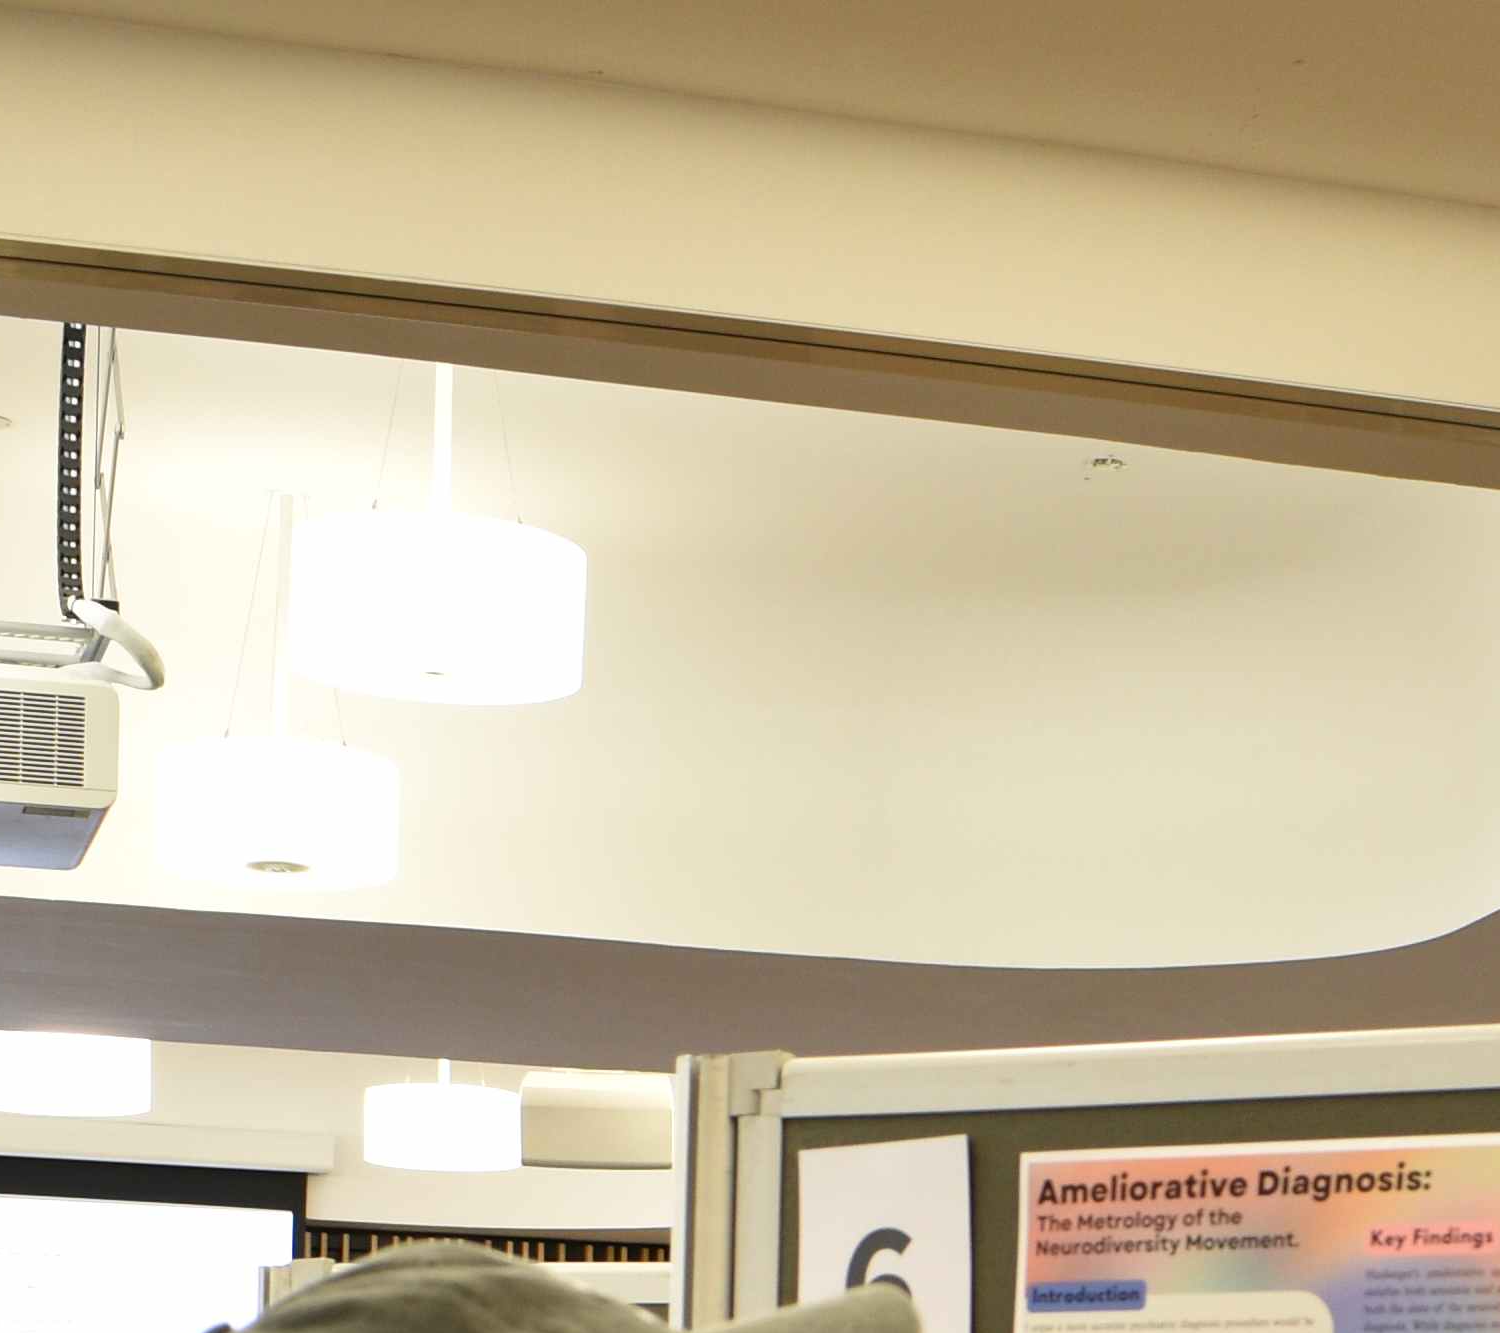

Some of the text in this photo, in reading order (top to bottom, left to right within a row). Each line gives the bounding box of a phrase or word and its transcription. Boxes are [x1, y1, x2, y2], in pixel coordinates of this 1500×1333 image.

[1038, 1161, 1432, 1205] Ameliorative Diagnosis:
[1038, 1209, 1242, 1235] The Metrology of the
[1036, 1231, 1300, 1257] Neurodiversity Movement.
[1370, 1227, 1493, 1250] Key Findings
[1032, 1286, 1140, 1305] Introduction
